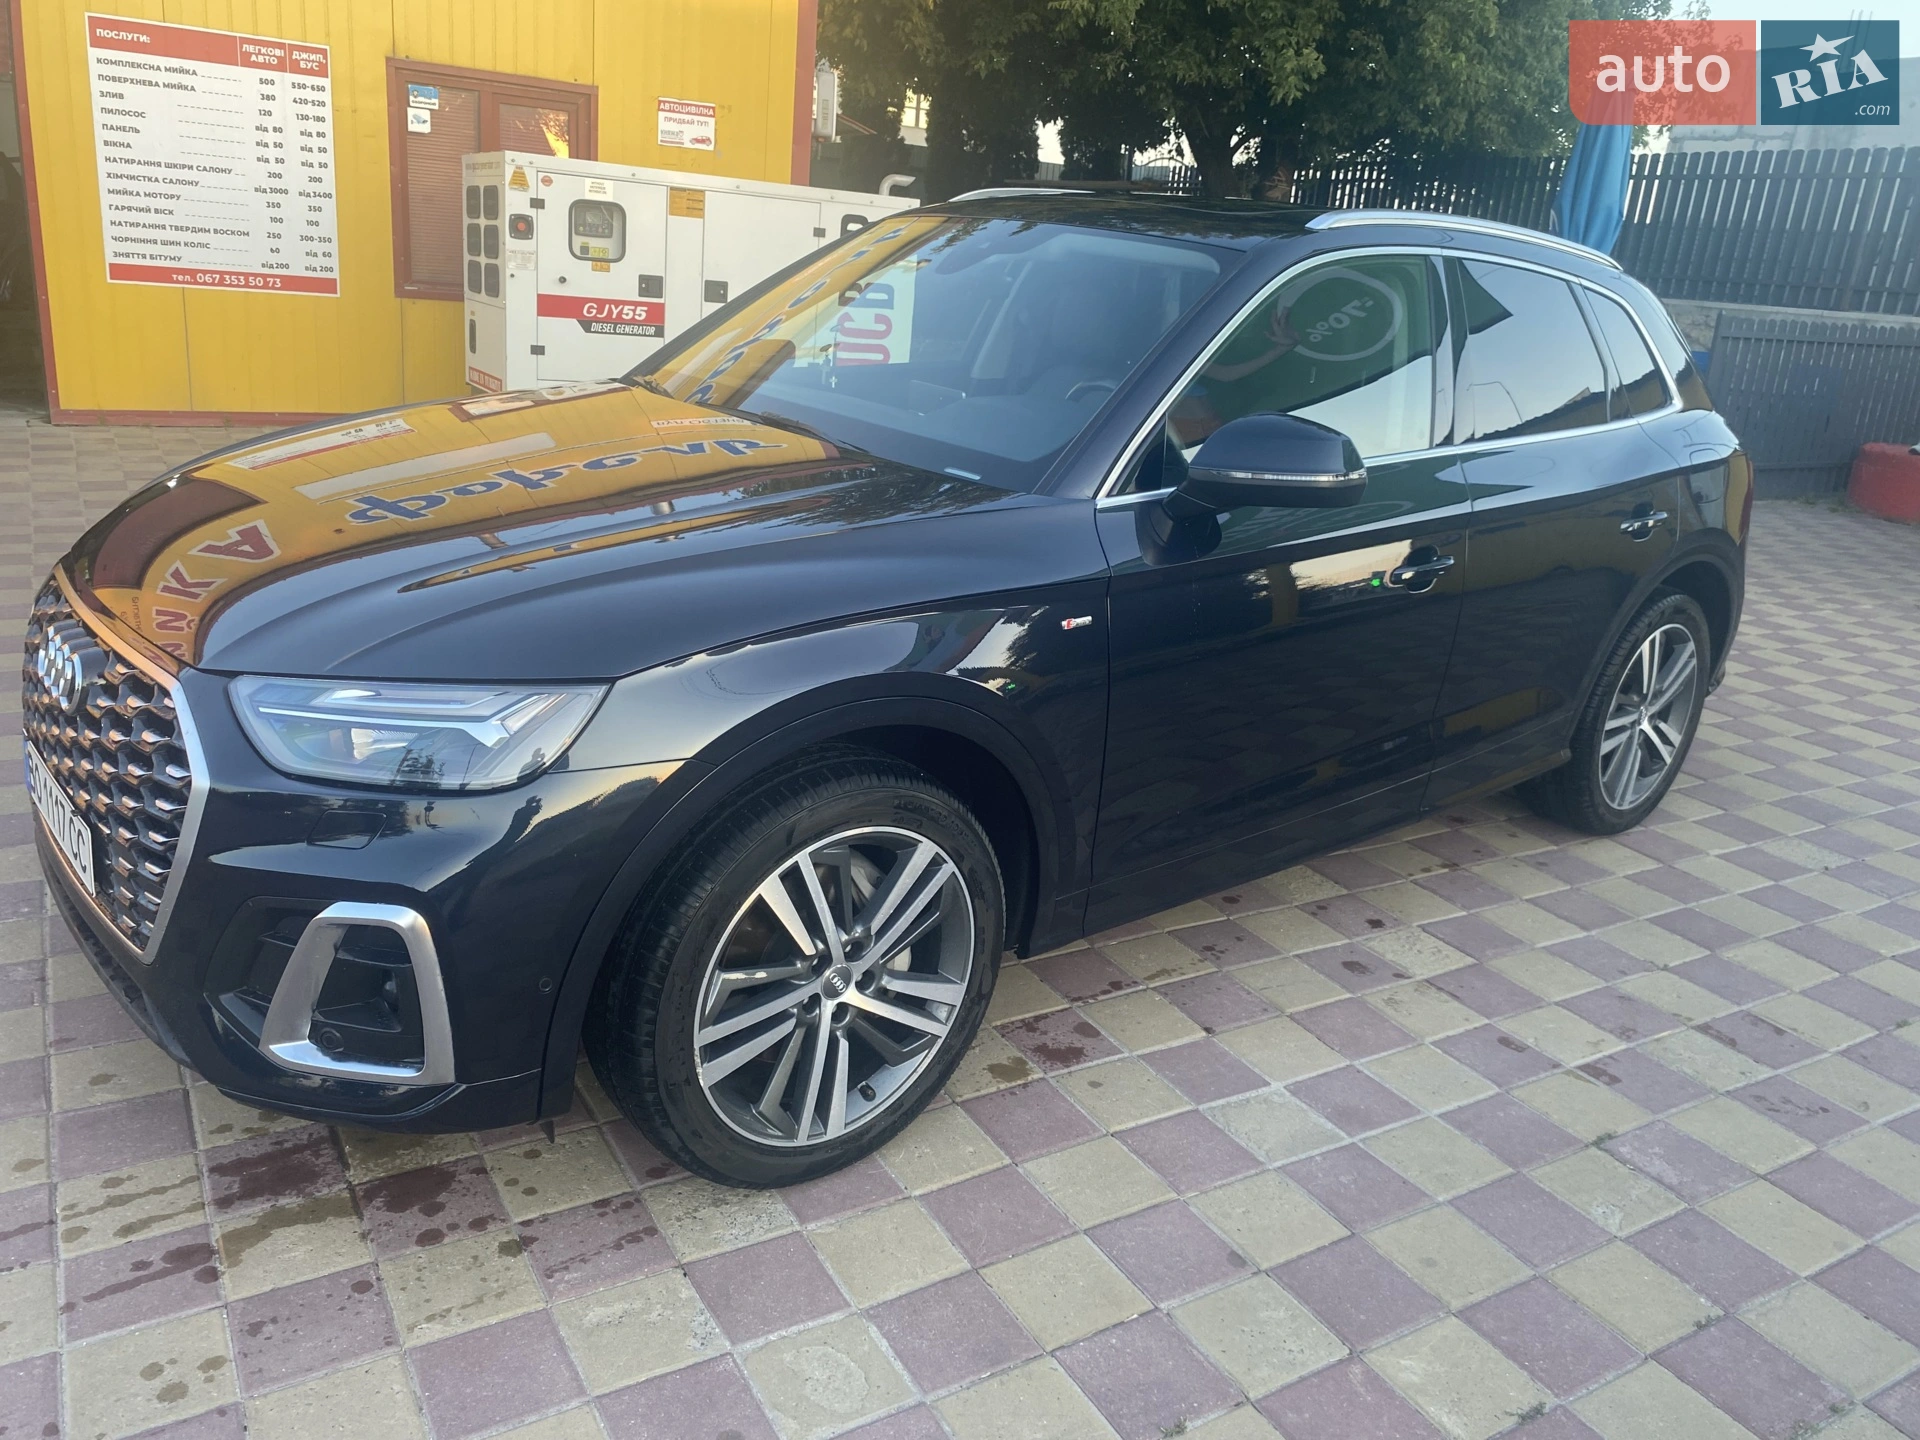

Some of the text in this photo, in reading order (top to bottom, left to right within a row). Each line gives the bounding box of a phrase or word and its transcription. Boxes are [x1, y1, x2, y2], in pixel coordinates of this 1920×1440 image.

[96, 28, 151, 43] ПОСЛУГИ:
[242, 44, 285, 57] ЛЕГКОВІ
[250, 54, 278, 65] АВТО
[292, 50, 326, 64] ДЖИП,
[96, 57, 198, 77] КОМПЛЕКСНА МИЙКА
[300, 61, 319, 71] БУС
[98, 74, 197, 92] ПОВЕРХНЕВА МИЙКА
[259, 78, 275, 86] 500
[291, 82, 326, 92] 550-650
[99, 90, 124, 100] ЗЛИВ
[260, 93, 276, 101] 380
[292, 97, 326, 108] 420-520
[101, 107, 146, 118] ПИЛОСОС
[258, 109, 272, 117] 120
[296, 113, 326, 123] 130-180
[102, 124, 140, 134] ПАНЕЛЬ
[255, 124, 283, 134] від 80
[300, 129, 326, 139] від 80
[103, 140, 132, 149] ВІКНА
[256, 140, 283, 149] від 50
[300, 145, 313, 153] від
[256, 155, 285, 165] від 50
[301, 160, 314, 169] від
[104, 156, 233, 175] НАТИРАННЯ ШКІРИ САЛОНУ
[106, 172, 200, 187] ХІМЧИСТКА САЛОНУ
[107, 187, 181, 201] МИЙКА МОТОРУ
[254, 185, 289, 195] від 3000
[299, 190, 311, 198] від
[109, 204, 175, 216] ГАРЯЧИЙ ВІСК
[110, 220, 250, 237] НАТИРАННЯ ТВЕРДИМ ВОСКОМ
[111, 235, 211, 249] ЧОРНІННЯ ШИН КОЛІС
[299, 235, 332, 244] 300-350
[112, 251, 182, 263] ЗНЯТТЯ БІТУМУ
[305, 250, 318, 258] від
[261, 261, 290, 270] від 200
[305, 264, 334, 273] від 200
[172, 273, 282, 288] тел. 067 353 50 73
[582, 302, 648, 321] GJY55
[591, 322, 656, 336] DIESEL GENERATOR
[69, 816, 87, 874] CC
